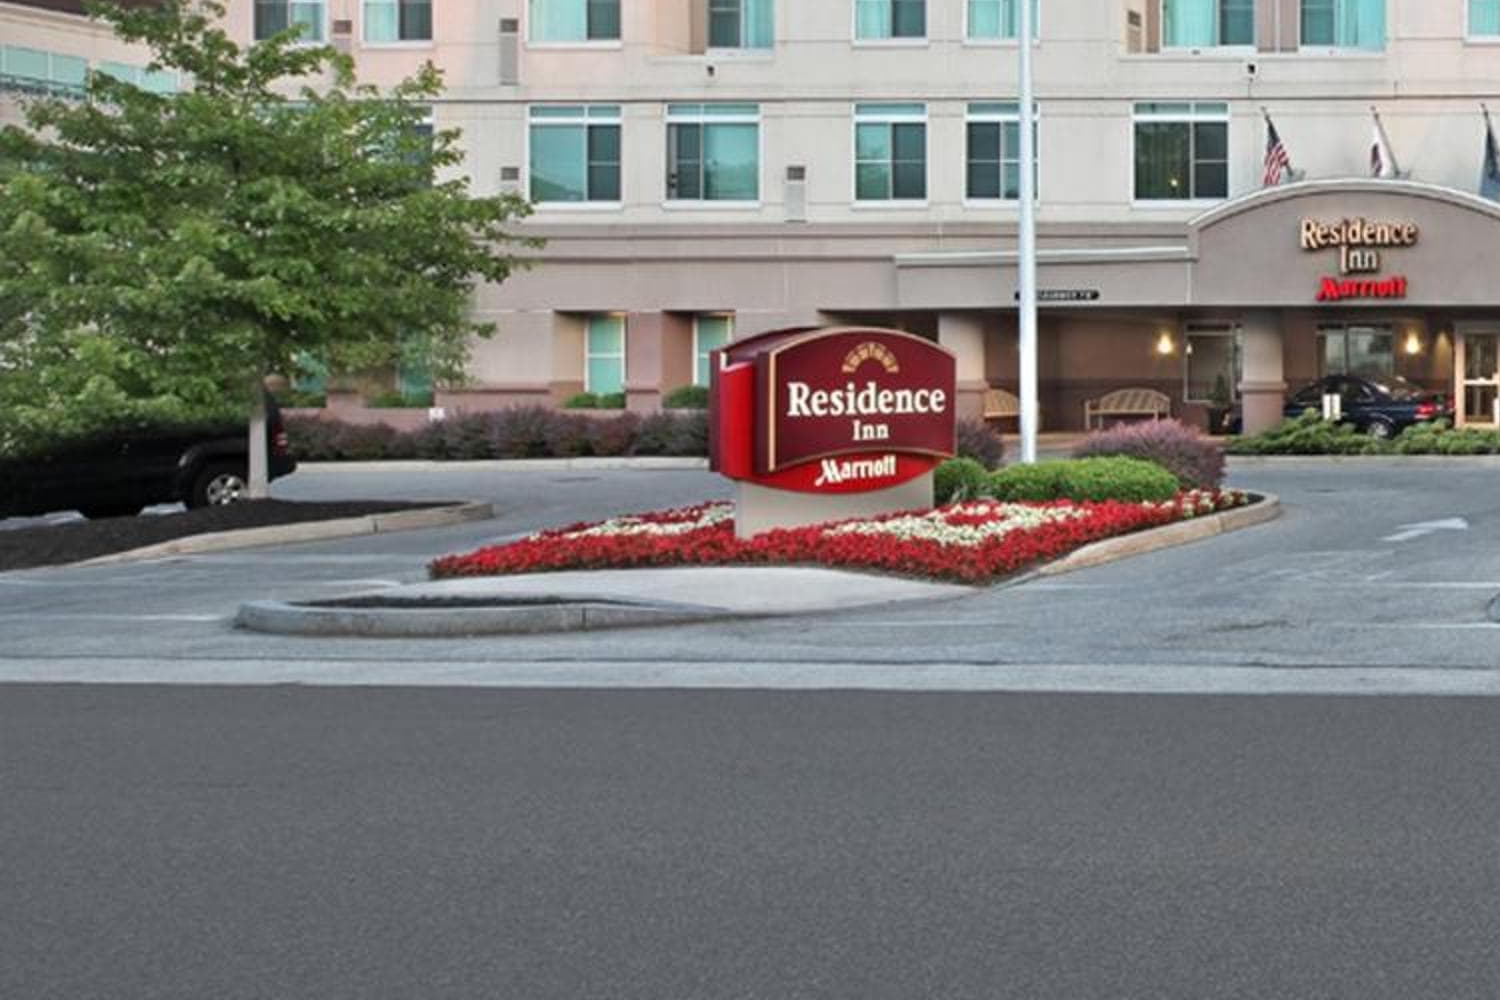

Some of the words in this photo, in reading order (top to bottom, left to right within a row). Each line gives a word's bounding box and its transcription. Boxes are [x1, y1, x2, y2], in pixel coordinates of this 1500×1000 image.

[1300, 216, 1418, 249] Residence
[1340, 246, 1379, 273] Inn
[1316, 276, 1407, 301] Marriott
[787, 381, 946, 417] Residence
[852, 419, 890, 441] Inn
[814, 454, 897, 487] Marriott
